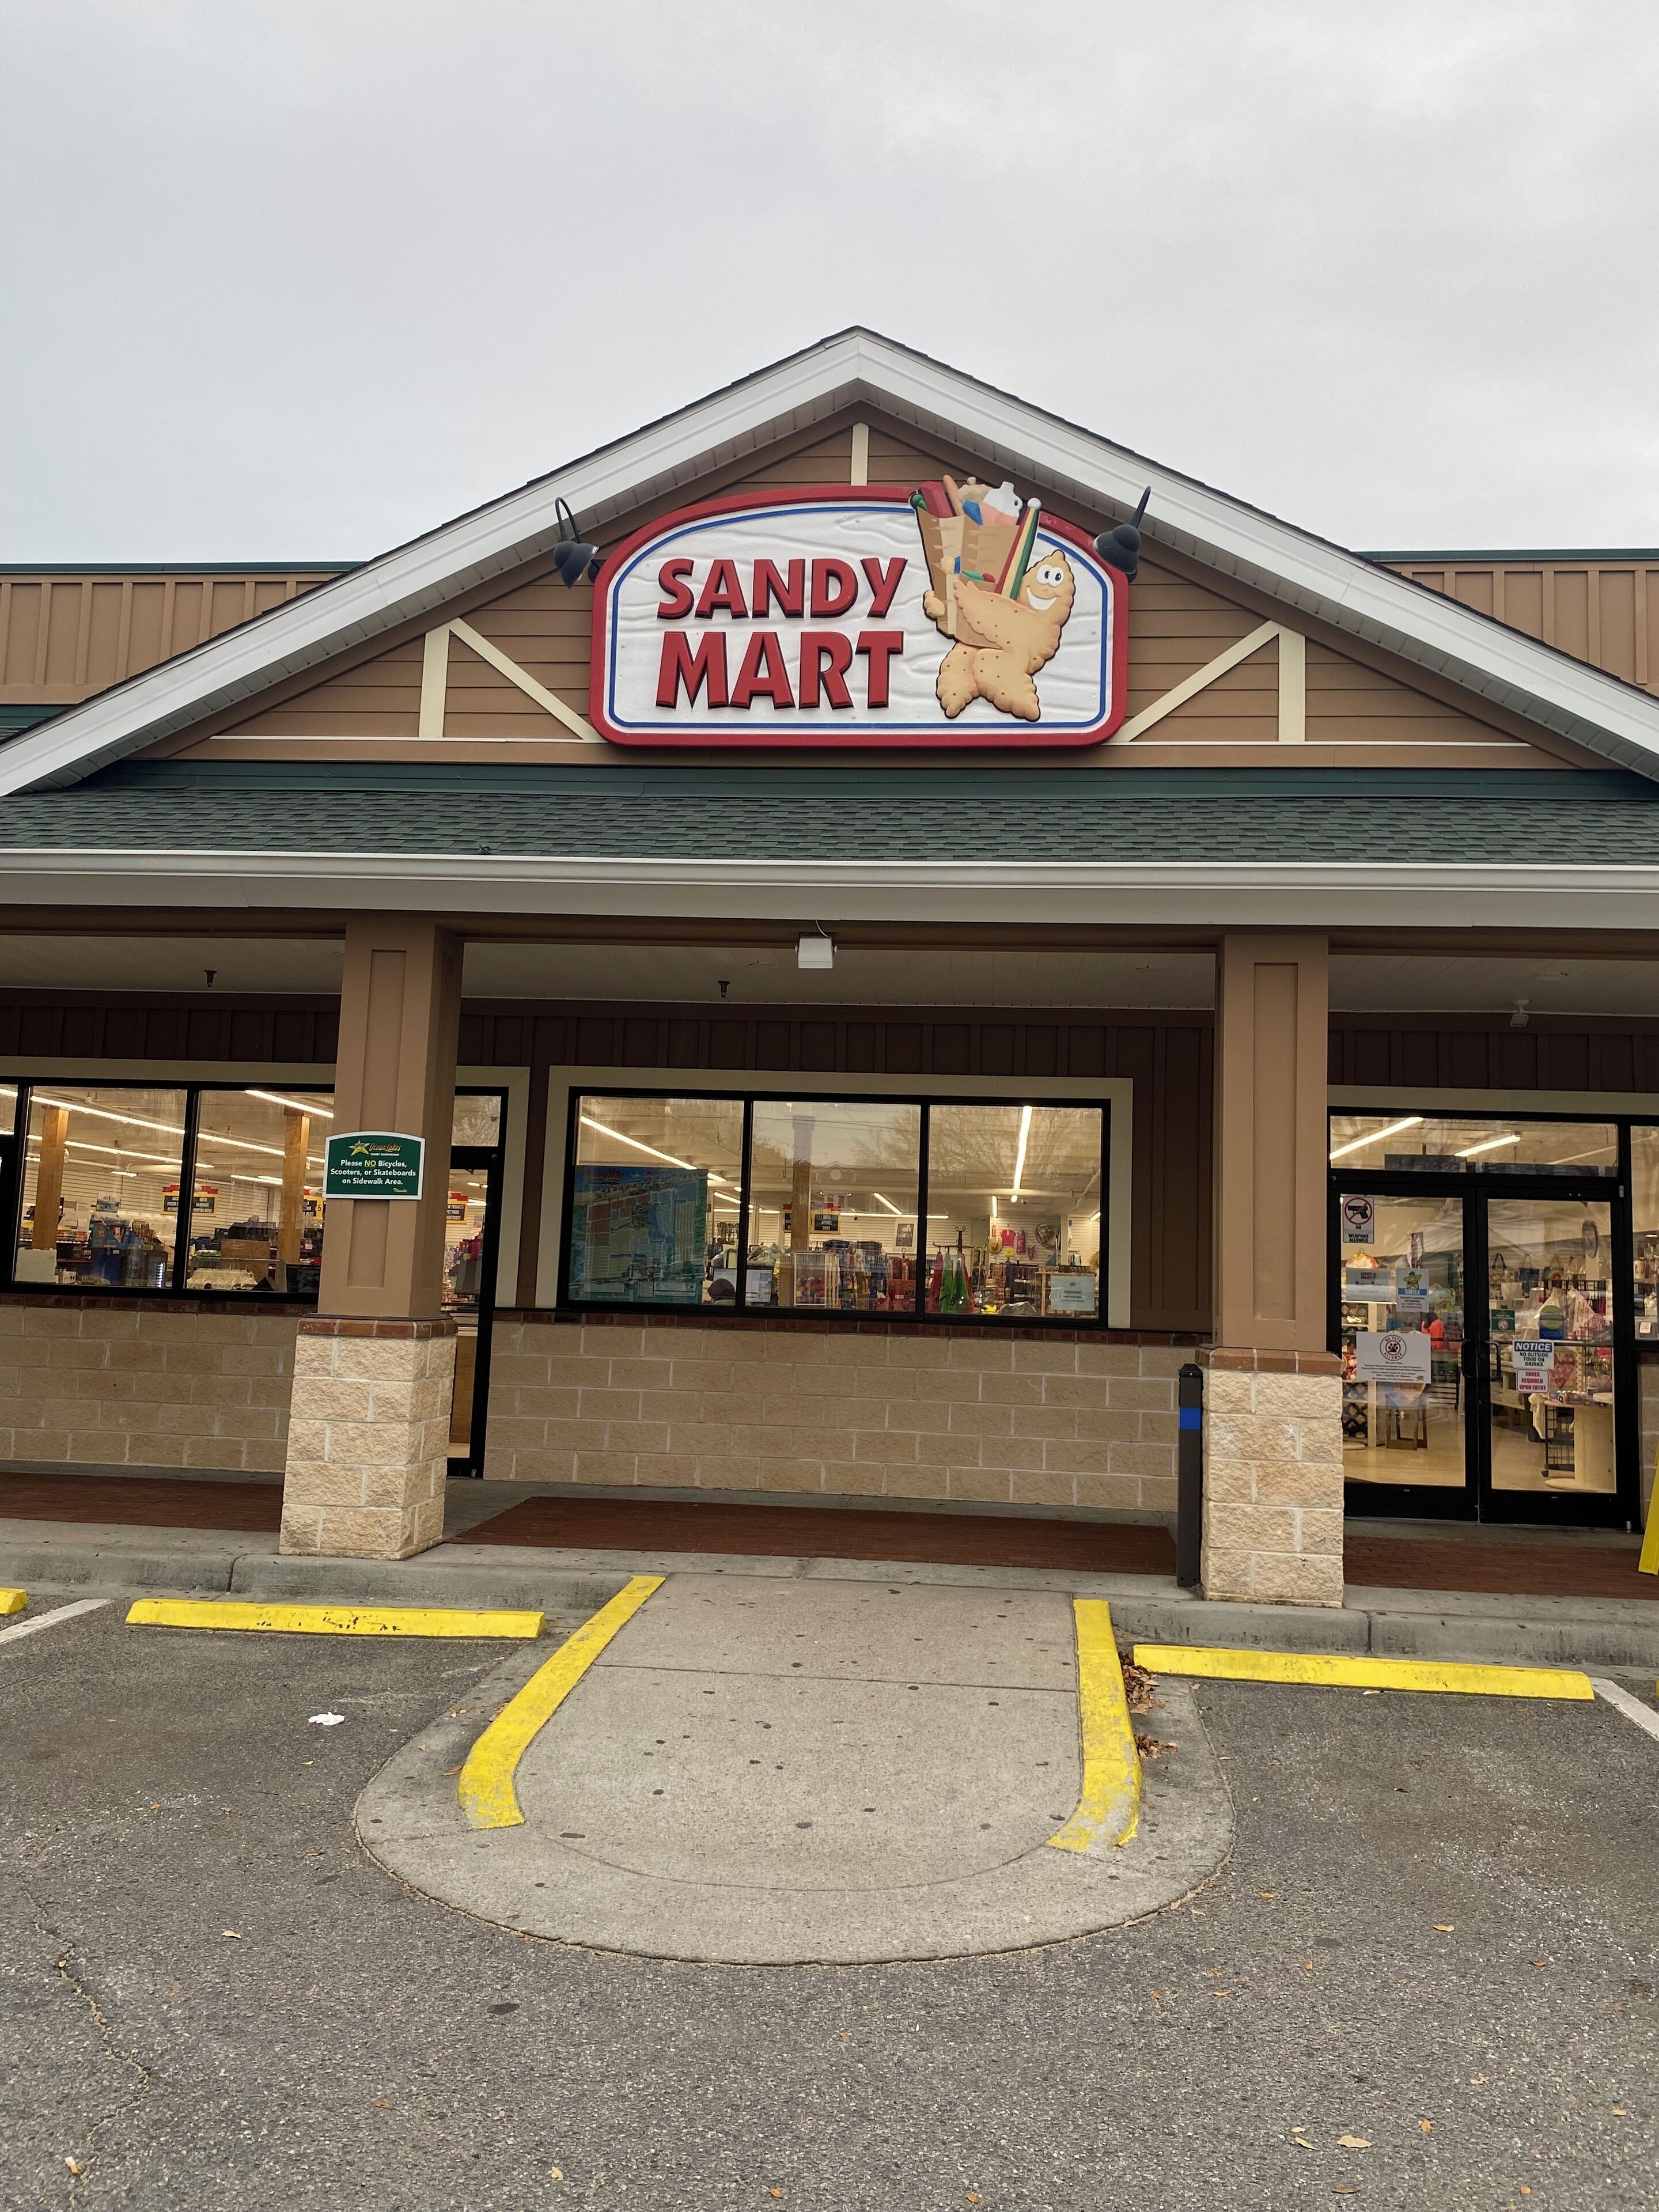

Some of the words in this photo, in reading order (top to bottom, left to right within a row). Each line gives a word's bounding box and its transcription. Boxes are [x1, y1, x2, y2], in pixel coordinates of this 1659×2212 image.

[656, 557, 908, 619] SANDY
[655, 631, 904, 710] MART
[378, 1160, 407, 1168] Bicycles,
[317, 1204, 321, 1212] 5
[1516, 1342, 1551, 1351] NOTICE
